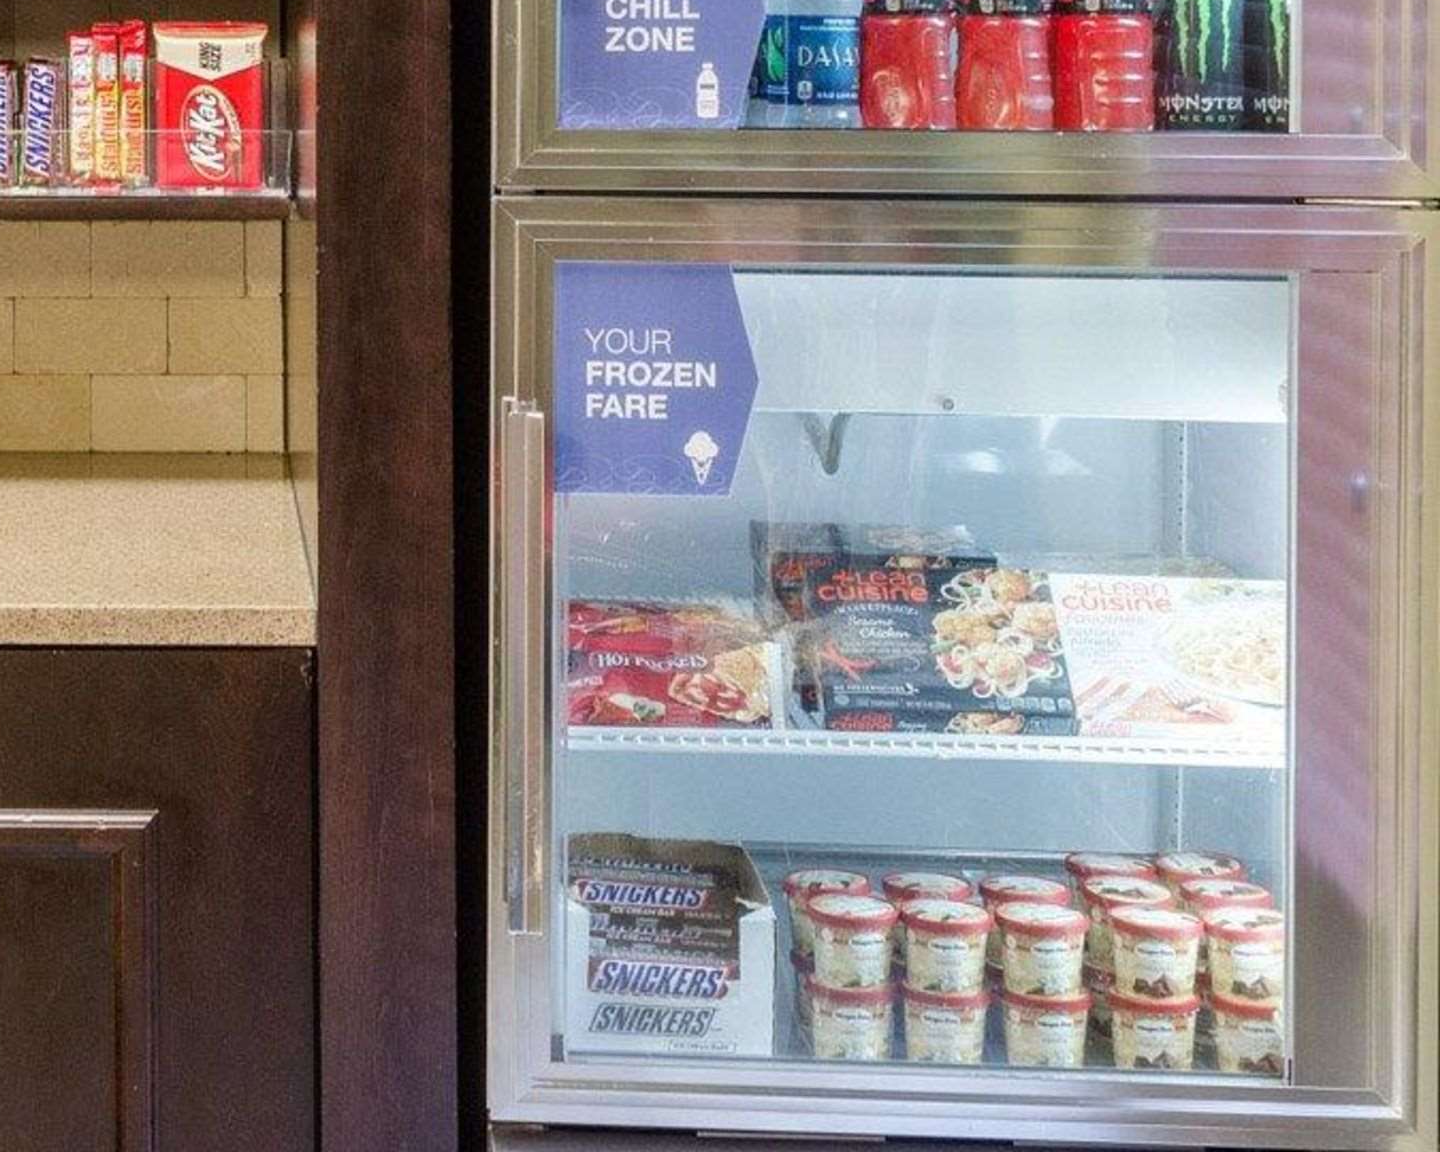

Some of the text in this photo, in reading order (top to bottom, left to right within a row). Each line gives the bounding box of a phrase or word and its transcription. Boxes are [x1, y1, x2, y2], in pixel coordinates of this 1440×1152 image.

[605, 27, 695, 53] ZONE
[797, 45, 857, 68] DASA
[1160, 94, 1245, 113] MONSTER
[25, 66, 56, 174] SNICKERS
[585, 328, 672, 354] YOUR
[586, 361, 716, 387] FROZEN
[586, 394, 668, 419] FARE
[587, 882, 702, 907] SNICKERS
[596, 962, 725, 999] SNICKERS
[594, 1003, 714, 1036] SNICKERS
